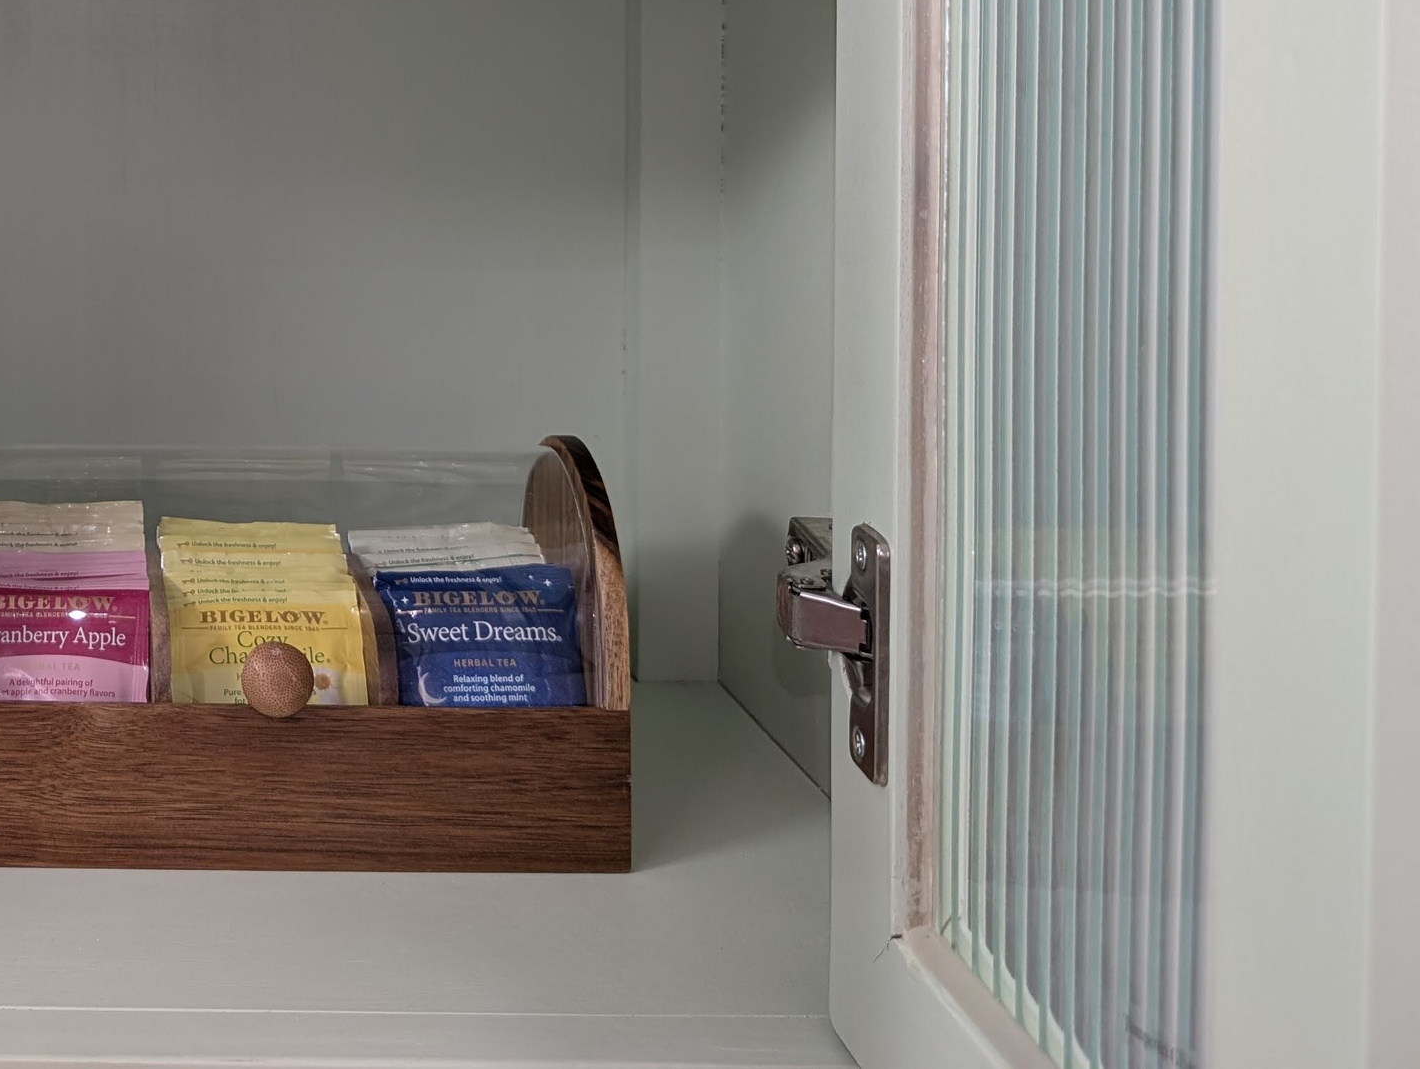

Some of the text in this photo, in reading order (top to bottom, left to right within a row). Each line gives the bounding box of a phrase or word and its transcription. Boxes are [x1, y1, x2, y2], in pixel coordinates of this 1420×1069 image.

[413, 590, 542, 606] BIGELOW
[199, 610, 326, 625] BIGELOW
[407, 620, 557, 643] Sweet Dreams
[72, 627, 126, 651] Apple
[209, 646, 325, 665] Chaile
[453, 659, 517, 667] HERBAL TEA
[16, 678, 54, 688] delightful
[55, 678, 83, 688] pairing
[84, 679, 93, 687] of
[453, 674, 524, 684] Relaxing blend of
[10, 688, 33, 697] apple
[50, 687, 89, 697] cranberry
[89, 689, 116, 698] flavors
[443, 683, 536, 693] comforting chamomile
[453, 693, 528, 703] and soothing mint
